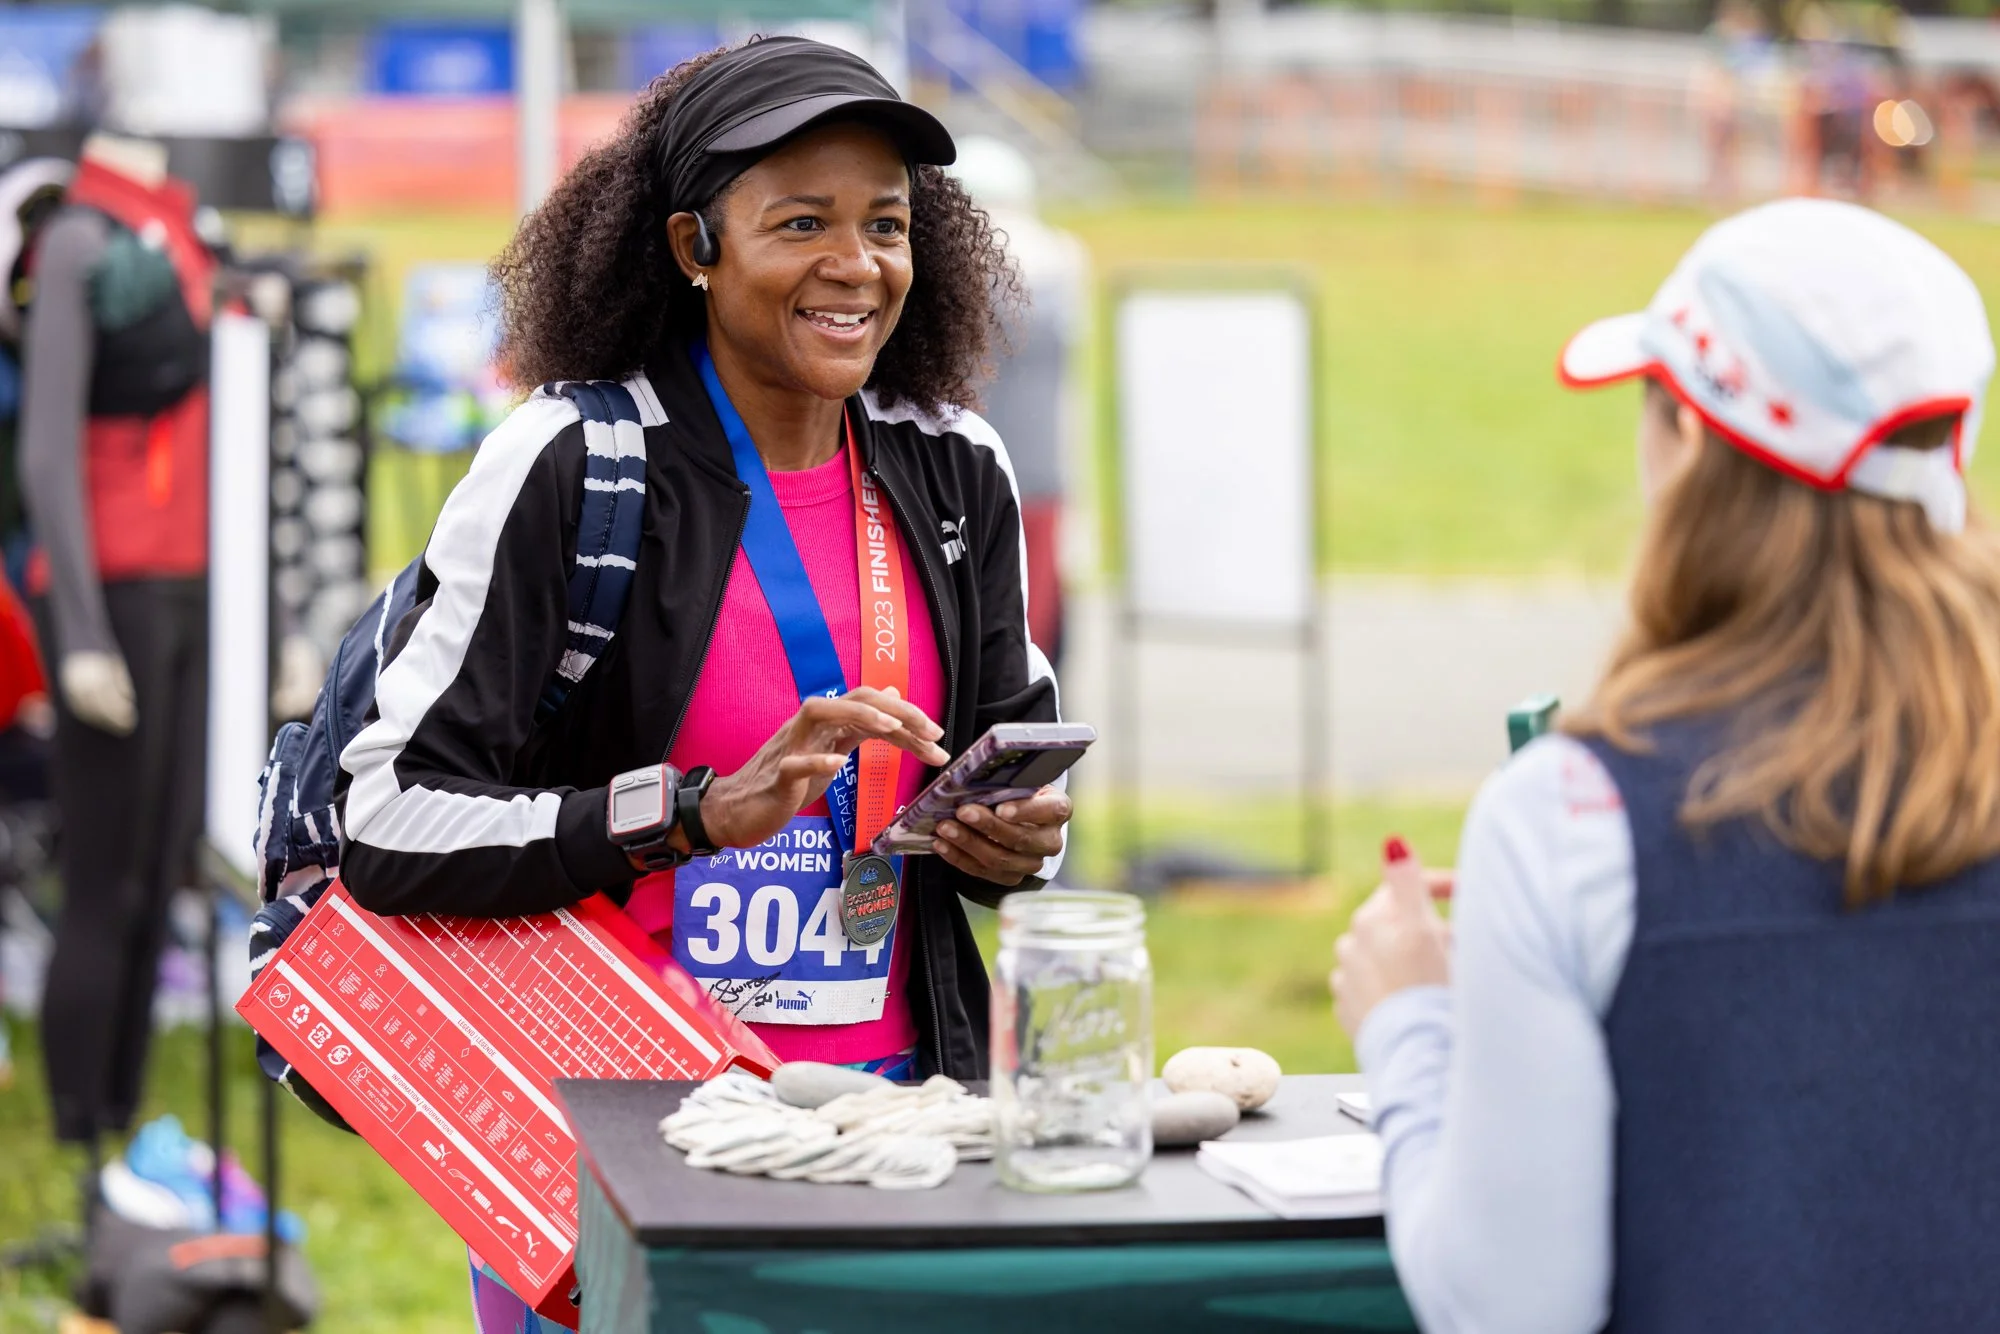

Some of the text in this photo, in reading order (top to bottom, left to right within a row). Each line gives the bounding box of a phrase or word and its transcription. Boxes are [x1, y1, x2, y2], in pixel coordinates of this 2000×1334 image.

[861, 471, 895, 662] 2023 FINISHER
[833, 785, 855, 837] START
[793, 829, 832, 849] 10K
[709, 850, 831, 872] for WOMEN
[856, 896, 895, 917] WOMEN
[556, 907, 617, 965] CONVERSION DE POINTURES
[272, 988, 286, 1003] PVC
[776, 999, 808, 1010] PUMA
[456, 1017, 475, 1037] LEGEND
[474, 1035, 497, 1058] LÉGENDE
[390, 1072, 421, 1103] INFORMATION
[420, 1102, 454, 1136] INFORMATIONS
[421, 1138, 443, 1161] PUMA
[470, 1187, 492, 1211] PUMA
